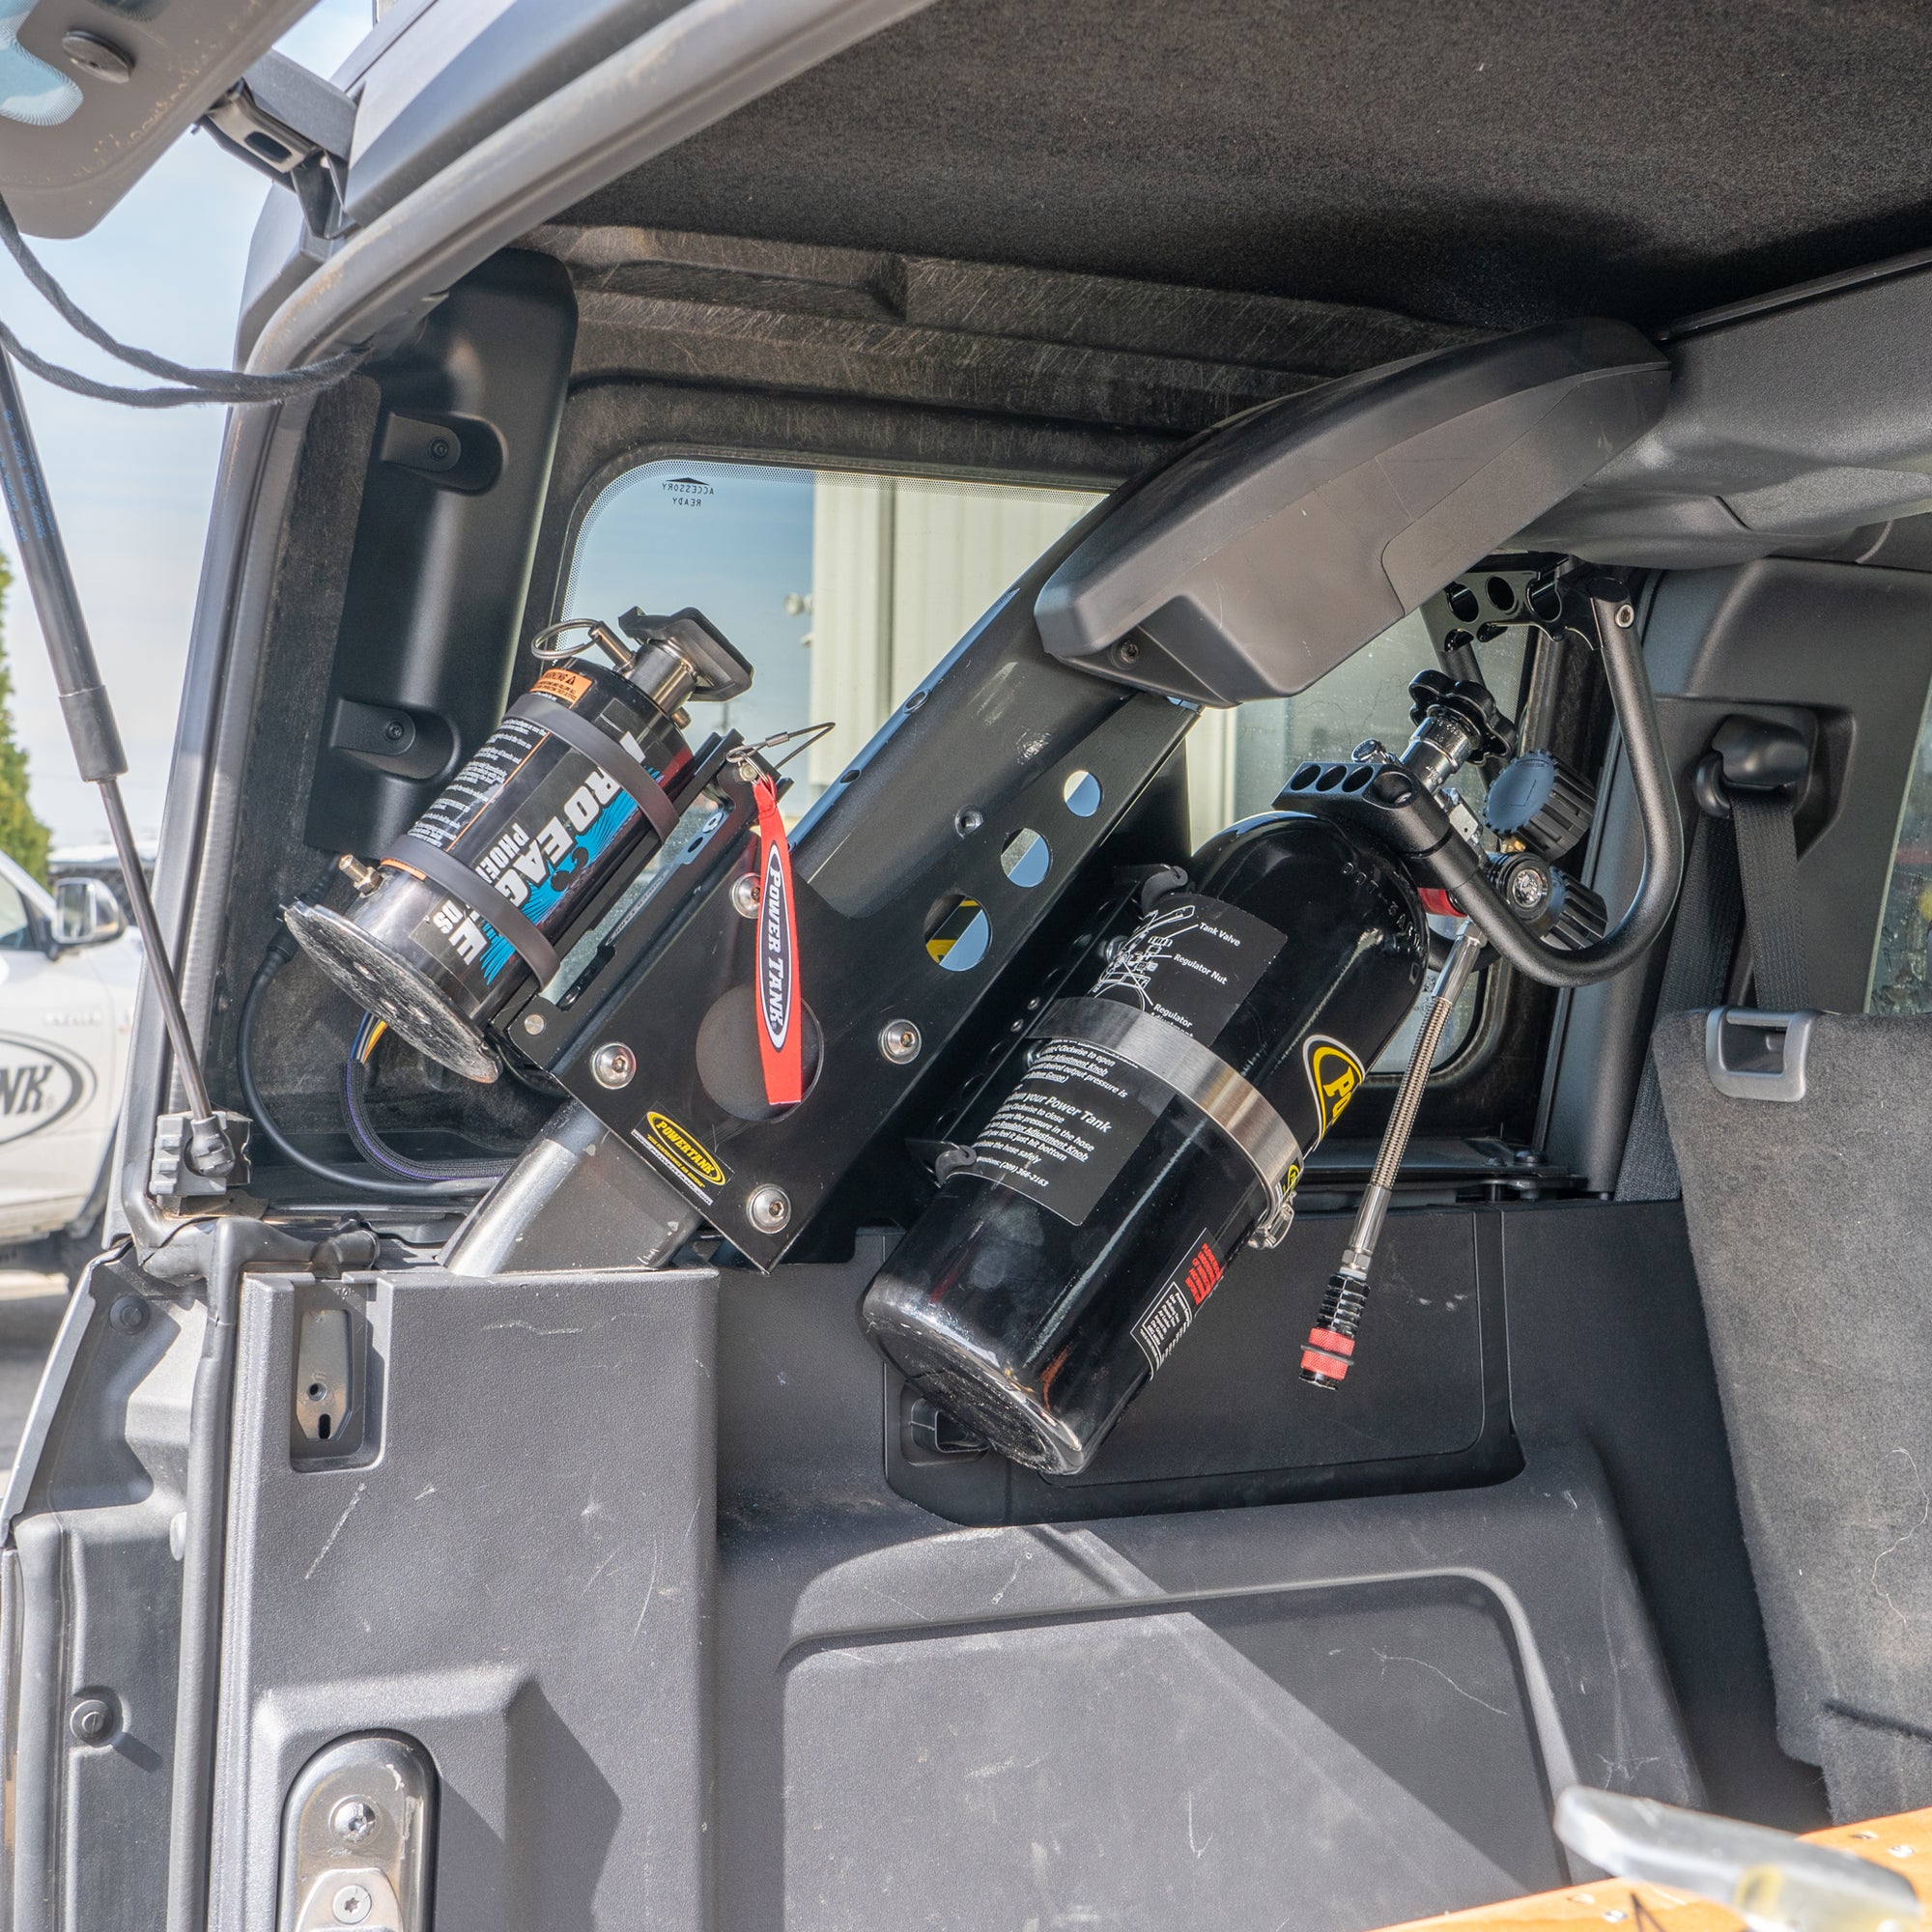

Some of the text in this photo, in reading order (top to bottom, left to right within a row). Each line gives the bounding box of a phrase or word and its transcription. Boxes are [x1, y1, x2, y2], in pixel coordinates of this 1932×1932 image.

[433, 899, 465, 935] DS
[769, 867, 784, 1027] POWER TANK
[1199, 922, 1241, 947] Tank Valve
[1173, 953, 1229, 985] Regulator Nut
[1152, 1004, 1193, 1028] Regulator
[1087, 1051, 1096, 1060] to
[1095, 1057, 1116, 1067] open
[1087, 1062, 1109, 1077] Knob
[1063, 1066, 1088, 1079] output
[1084, 1073, 1120, 1094] pressure
[1118, 1089, 1128, 1098] is
[1023, 1093, 1048, 1103] your
[1044, 1096, 1082, 1116] Power
[1080, 1110, 1113, 1133] Tank
[1044, 1111, 1065, 1123] close
[655, 1120, 716, 1176] POWERTANK
[1011, 1133, 1030, 1144] just
[1027, 1138, 1040, 1149] hit
[1037, 1143, 1067, 1161] bottom
[1021, 1116, 1053, 1131] pressure
[1051, 1125, 1062, 1134] in
[1060, 1128, 1075, 1141] the
[1072, 1136, 1095, 1152] hose
[1024, 1126, 1068, 1151] Adjustment
[1065, 1145, 1090, 1163] Knob
[1002, 1144, 1020, 1154] hose
[1017, 1150, 1042, 1165] safely
[999, 1161, 1018, 1174] (209)
[1015, 1166, 1050, 1187] 366-2163
